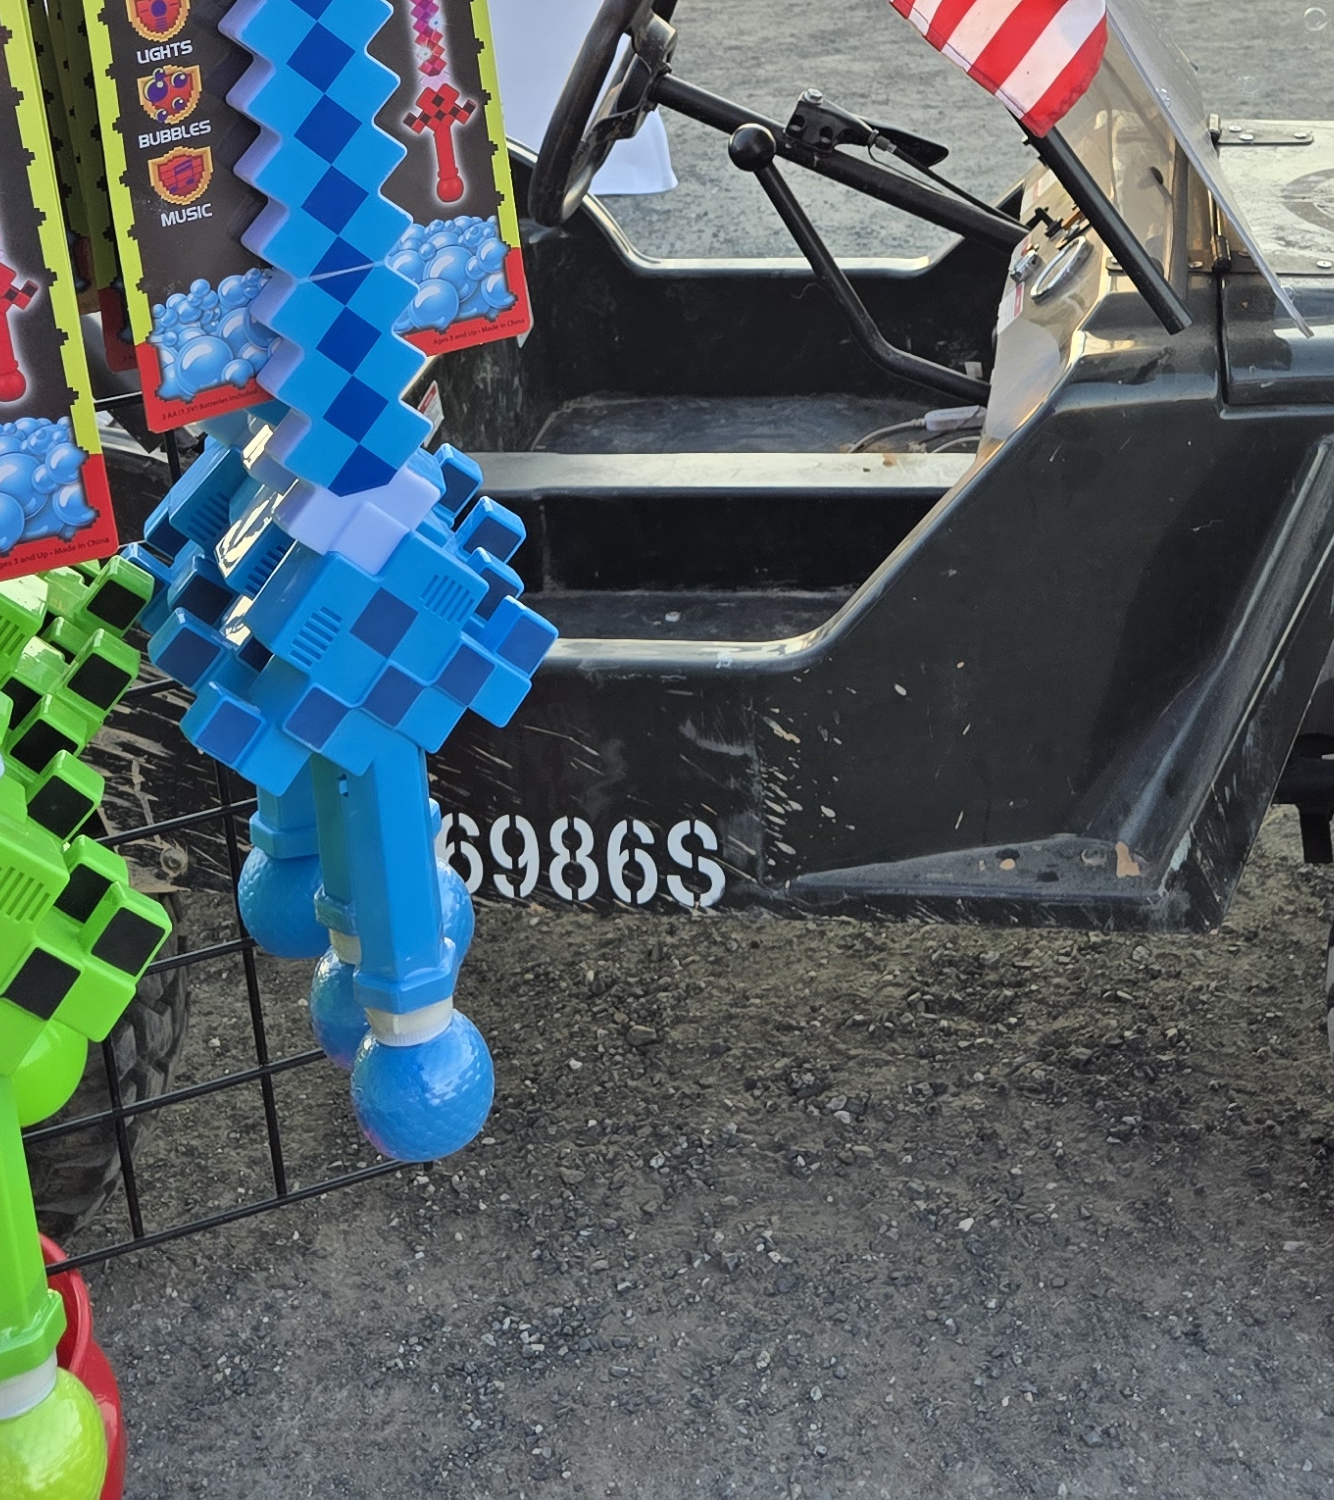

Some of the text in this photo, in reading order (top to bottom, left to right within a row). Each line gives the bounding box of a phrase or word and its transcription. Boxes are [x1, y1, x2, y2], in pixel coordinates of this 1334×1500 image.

[136, 40, 193, 65] LIGHTS
[138, 120, 212, 149] BUBBLES
[160, 202, 213, 228] MUSIC
[482, 324, 499, 332] Made
[507, 318, 525, 326] China
[168, 411, 177, 419] AA
[200, 398, 228, 410] Batteries
[20, 555, 35, 563] and
[37, 551, 48, 559] Up
[54, 545, 76, 555] Made
[78, 542, 85, 550] in
[87, 537, 110, 547] China
[438, 812, 726, 908] 6986S
